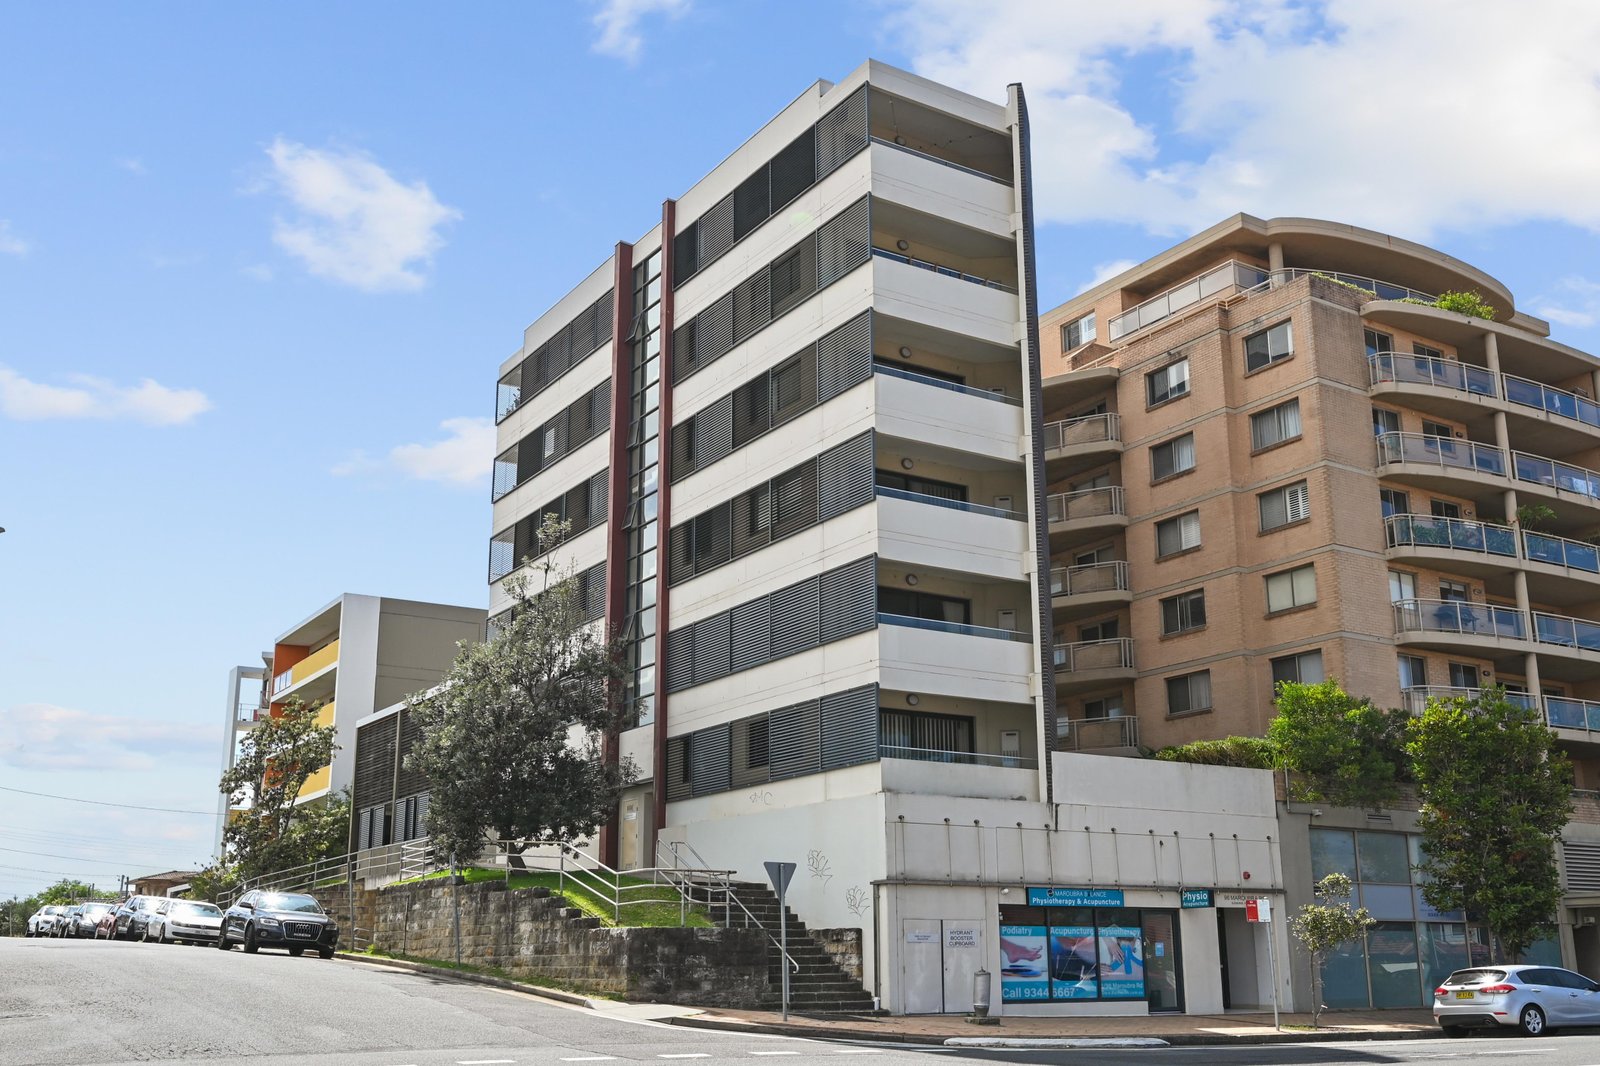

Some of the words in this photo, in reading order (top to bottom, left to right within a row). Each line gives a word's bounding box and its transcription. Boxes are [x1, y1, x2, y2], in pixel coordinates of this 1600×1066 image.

[1182, 890, 1208, 903] Physio
[1032, 897, 1075, 905] Physiotherapy
[1083, 898, 1120, 906] Acupuncture
[1002, 926, 1032, 936] Podiatry
[1050, 927, 1094, 936] Acupuncture
[1098, 928, 1141, 937] Physiotherapy
[1002, 988, 1021, 998] Call
[1024, 988, 1049, 998] 9344
